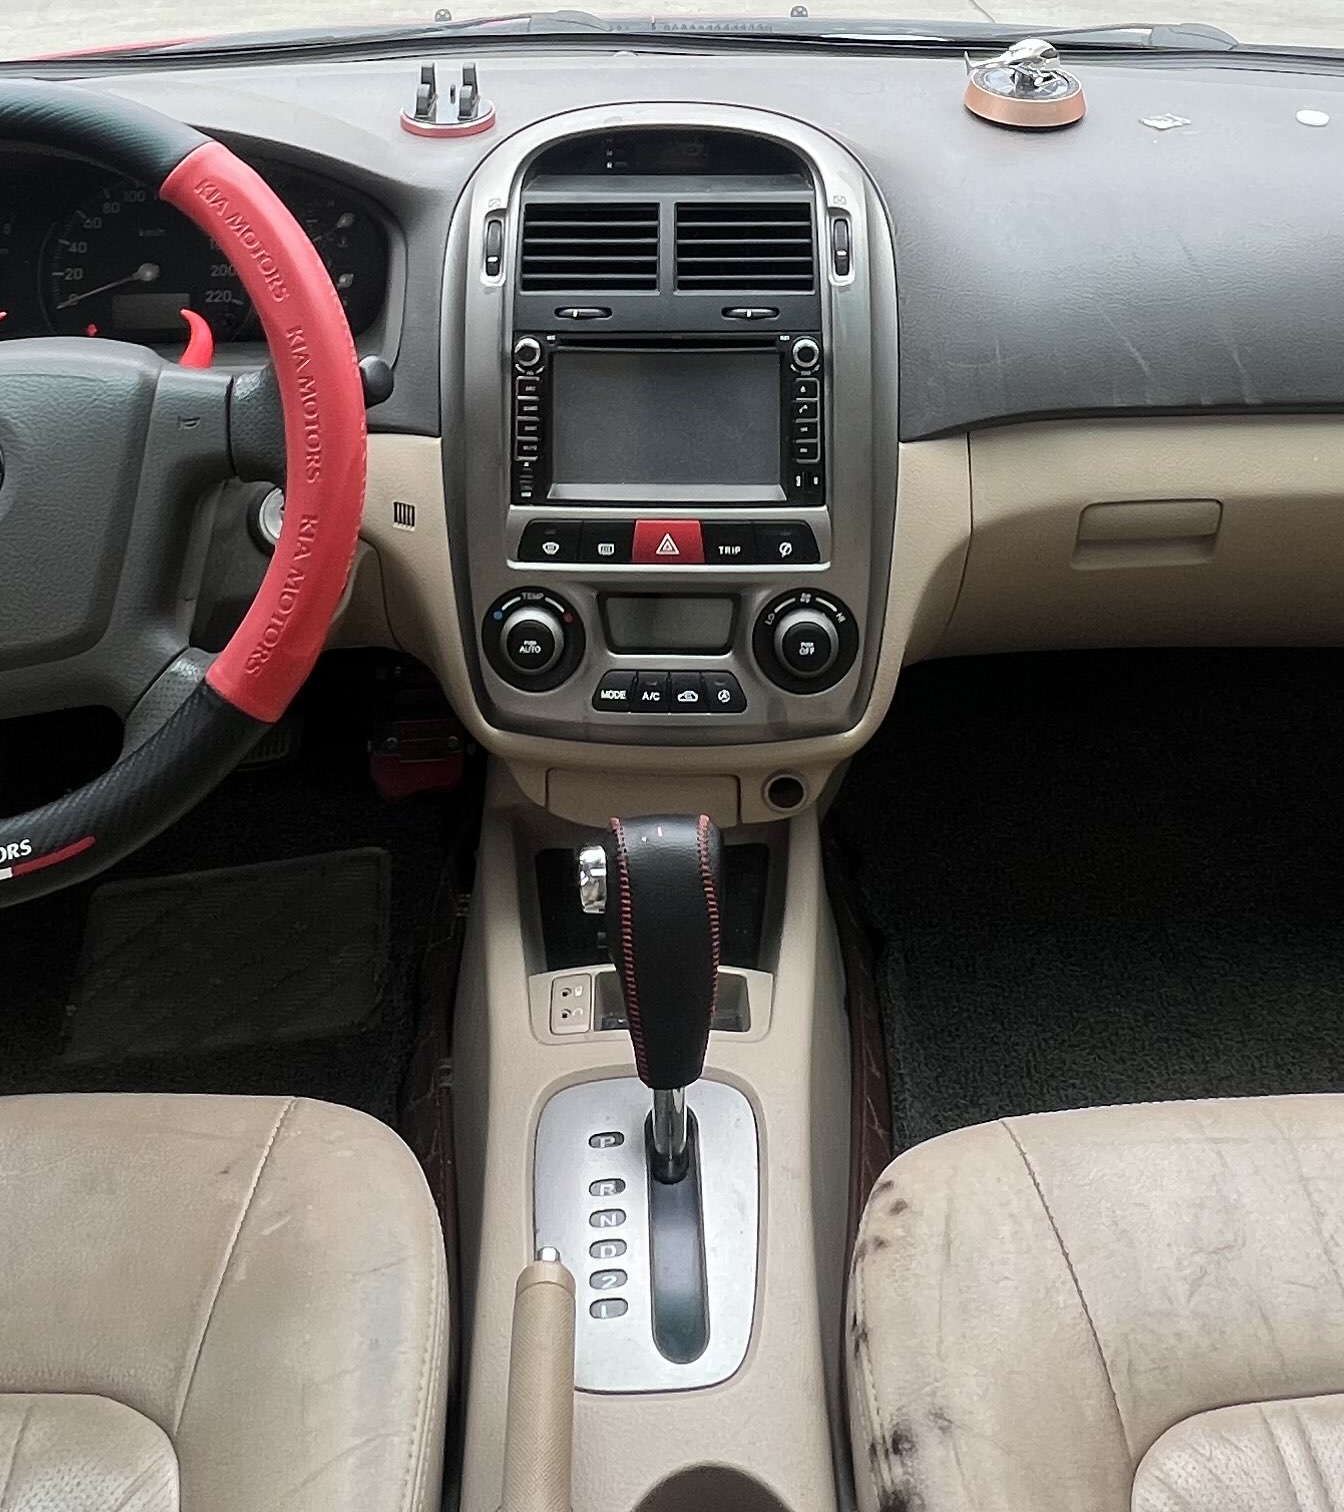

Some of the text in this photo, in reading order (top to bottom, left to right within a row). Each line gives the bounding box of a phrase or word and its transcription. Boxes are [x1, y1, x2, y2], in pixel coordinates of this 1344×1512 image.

[103, 202, 120, 214] 80
[83, 217, 102, 229] 60
[194, 178, 291, 303] KIA MOTORS
[68, 241, 88, 254] 40
[65, 268, 84, 281] 20
[206, 290, 232, 303] 220
[286, 325, 323, 484] KIA MOTORS
[718, 545, 741, 555] TRIP
[245, 513, 320, 676] KIA MOTORS
[521, 592, 545, 600] TEMP
[764, 613, 775, 625] LO
[519, 645, 541, 654] AUTO
[799, 647, 815, 656] OFF
[600, 689, 627, 700] MODE
[641, 691, 661, 701] A/C
